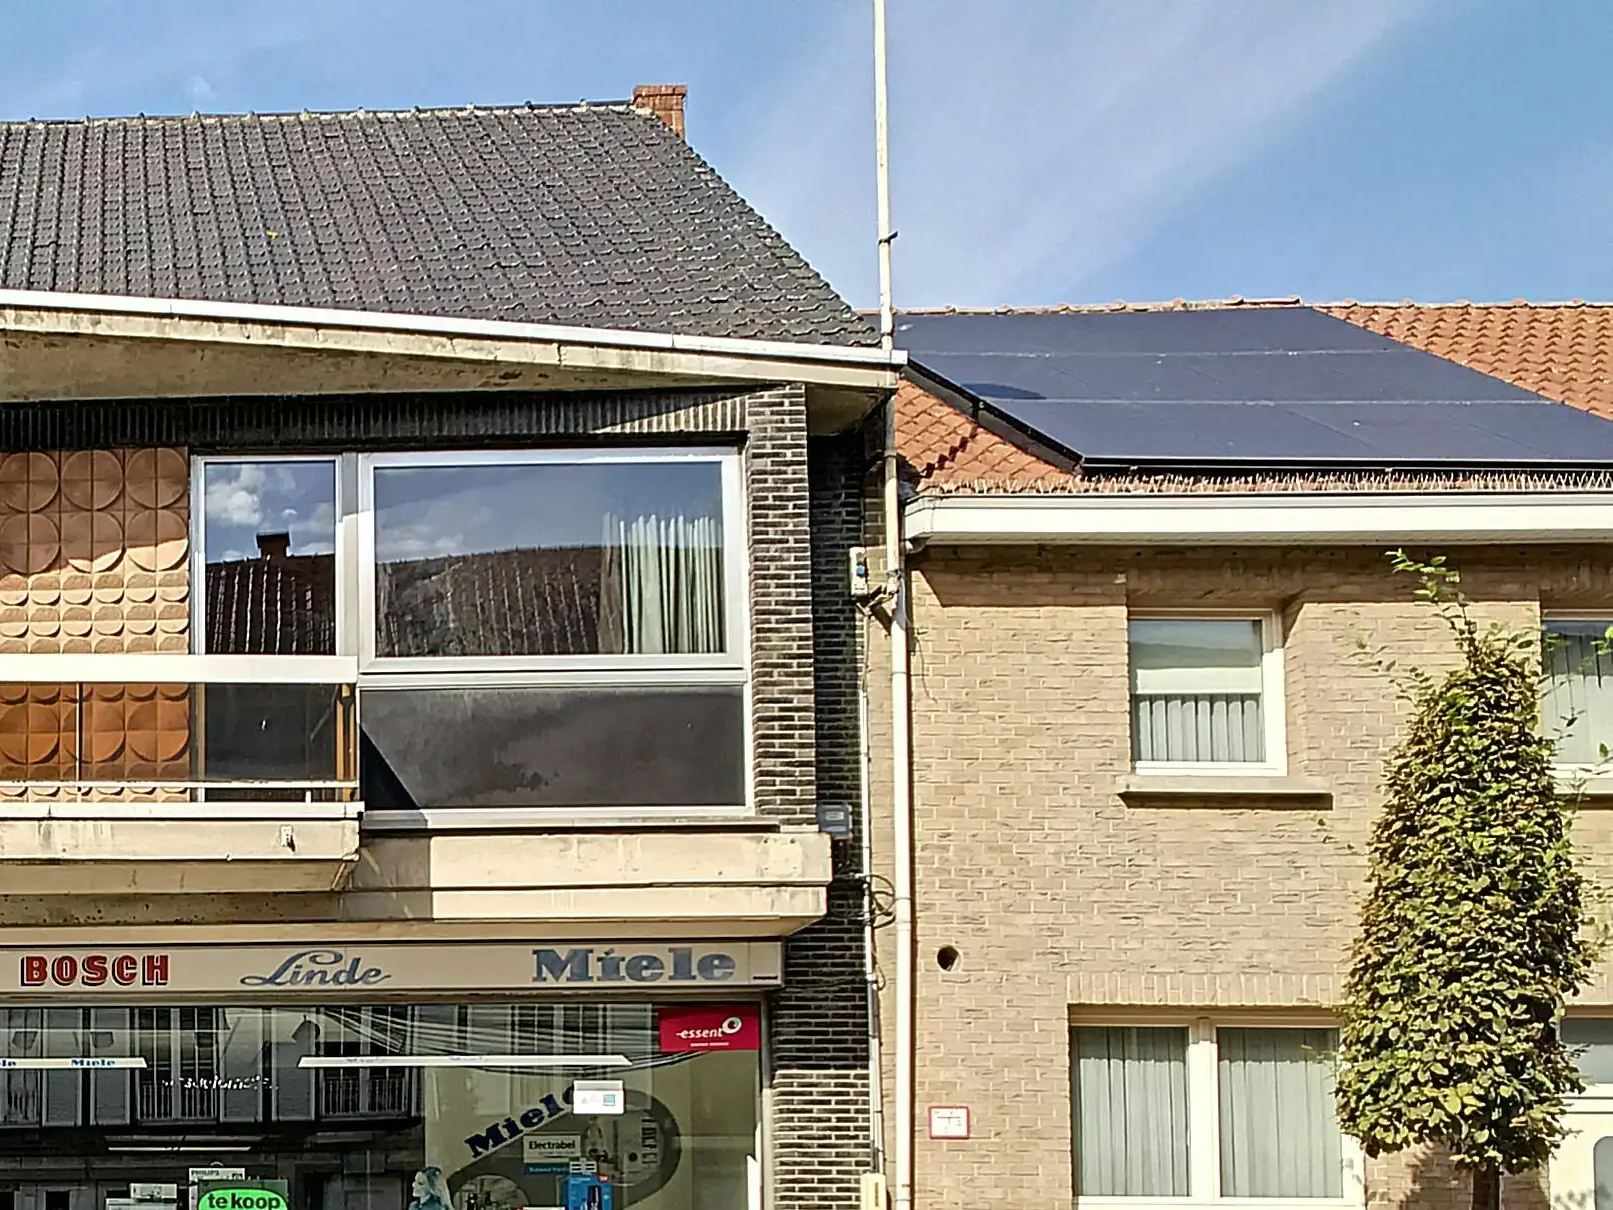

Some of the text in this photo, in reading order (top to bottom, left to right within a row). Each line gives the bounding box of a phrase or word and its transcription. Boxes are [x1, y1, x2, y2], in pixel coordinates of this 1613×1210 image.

[21, 953, 170, 986] BOSCH
[240, 949, 391, 987] Linde
[532, 948, 737, 983] Miele
[207, 1193, 227, 1209] te
